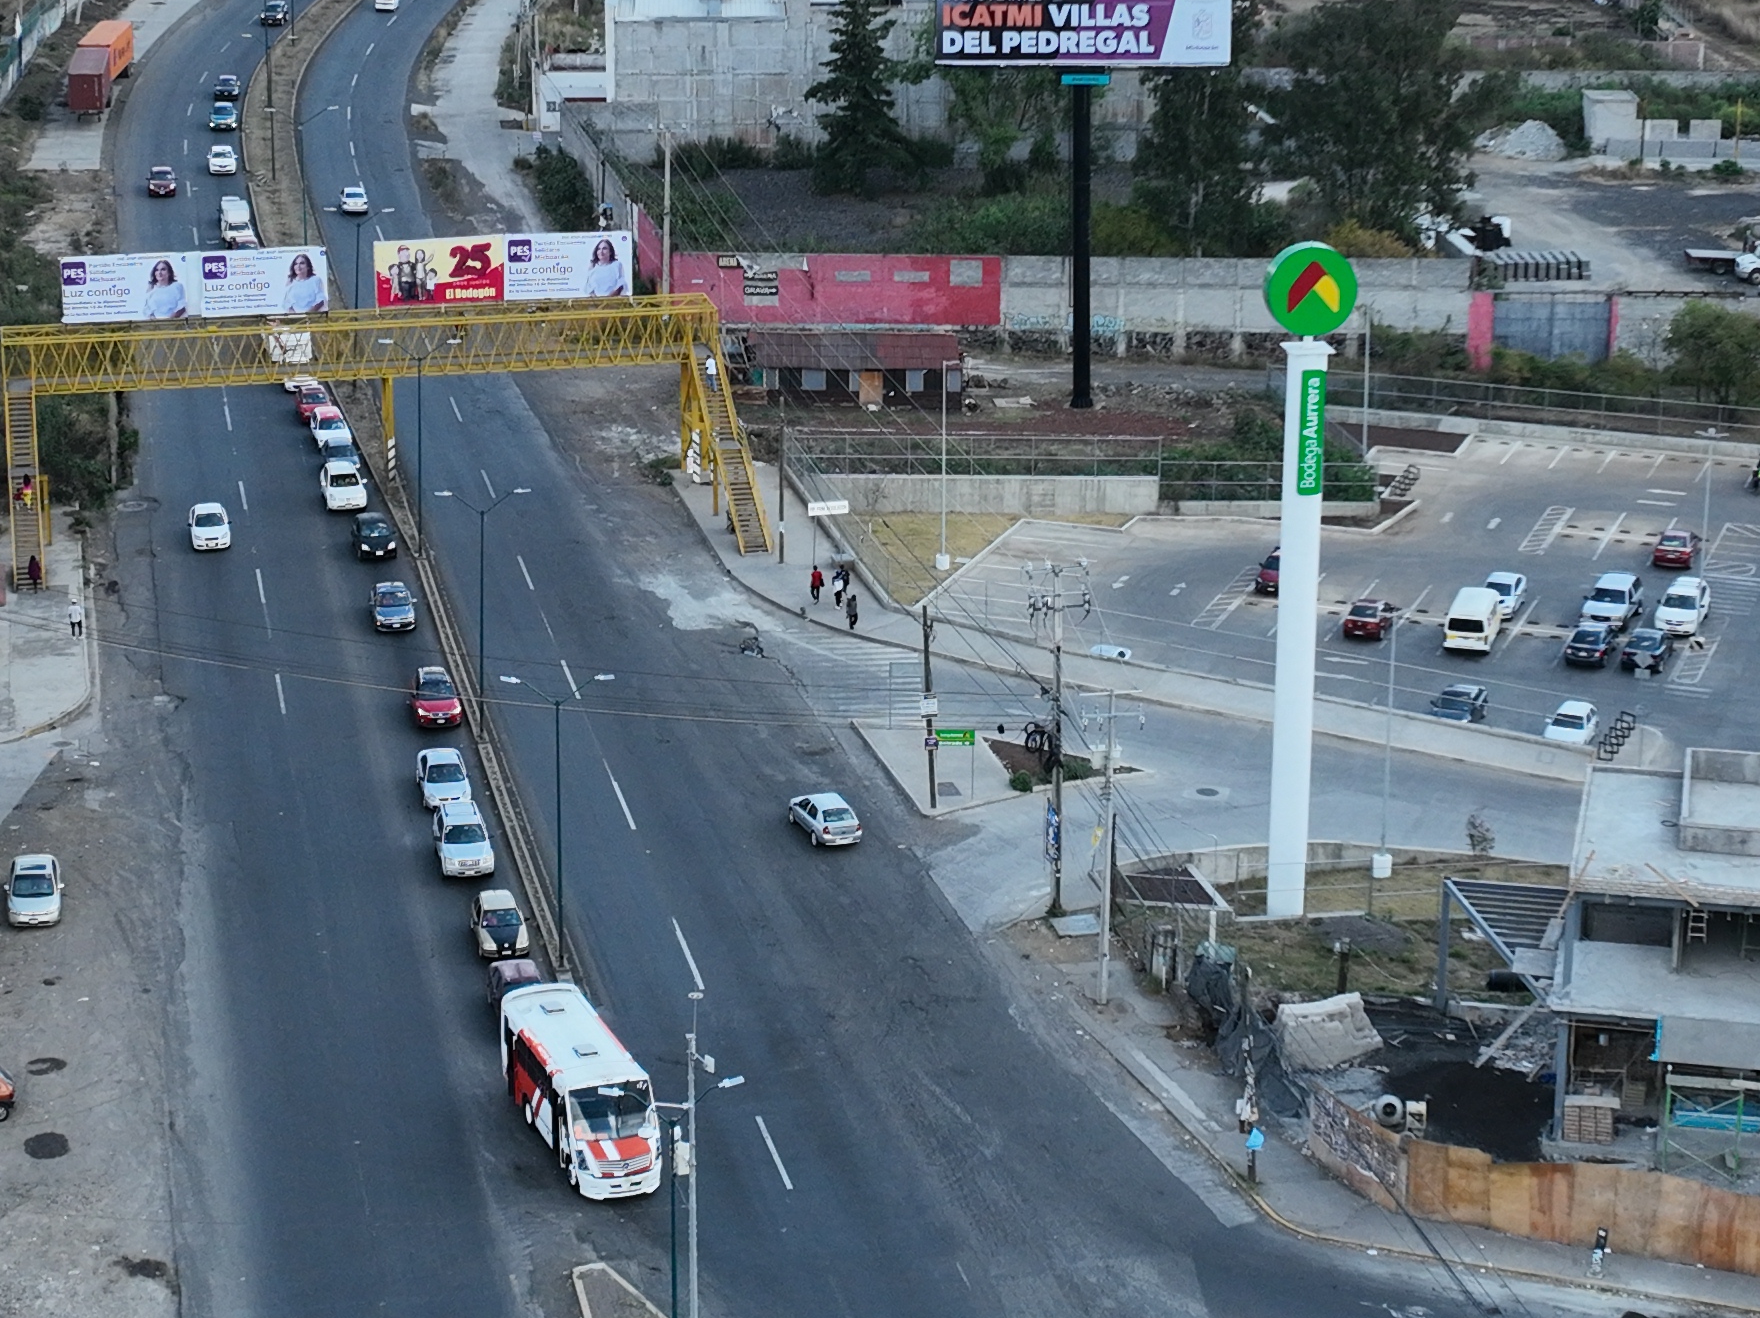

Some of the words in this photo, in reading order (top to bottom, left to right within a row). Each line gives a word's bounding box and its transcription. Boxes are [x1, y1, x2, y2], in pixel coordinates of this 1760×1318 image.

[942, 3, 1043, 27] ICATMI
[1048, 3, 1151, 27] VILLAS
[942, 30, 997, 54] DEL
[1001, 30, 1155, 54] PEDREGAL
[510, 245, 530, 256] PES
[448, 242, 492, 278] 25
[204, 262, 226, 273] PES
[508, 265, 529, 275] Luz
[531, 263, 573, 275] contigo
[63, 269, 85, 279] PES
[63, 289, 84, 298] Luz
[87, 285, 130, 298] contigo
[204, 282, 225, 292] Luz
[227, 280, 270, 292] contigo
[445, 288, 454, 299] El
[455, 287, 496, 299] Bodegón
[1302, 377, 1321, 438] Aurrera
[1300, 439, 1323, 489] Bodega
